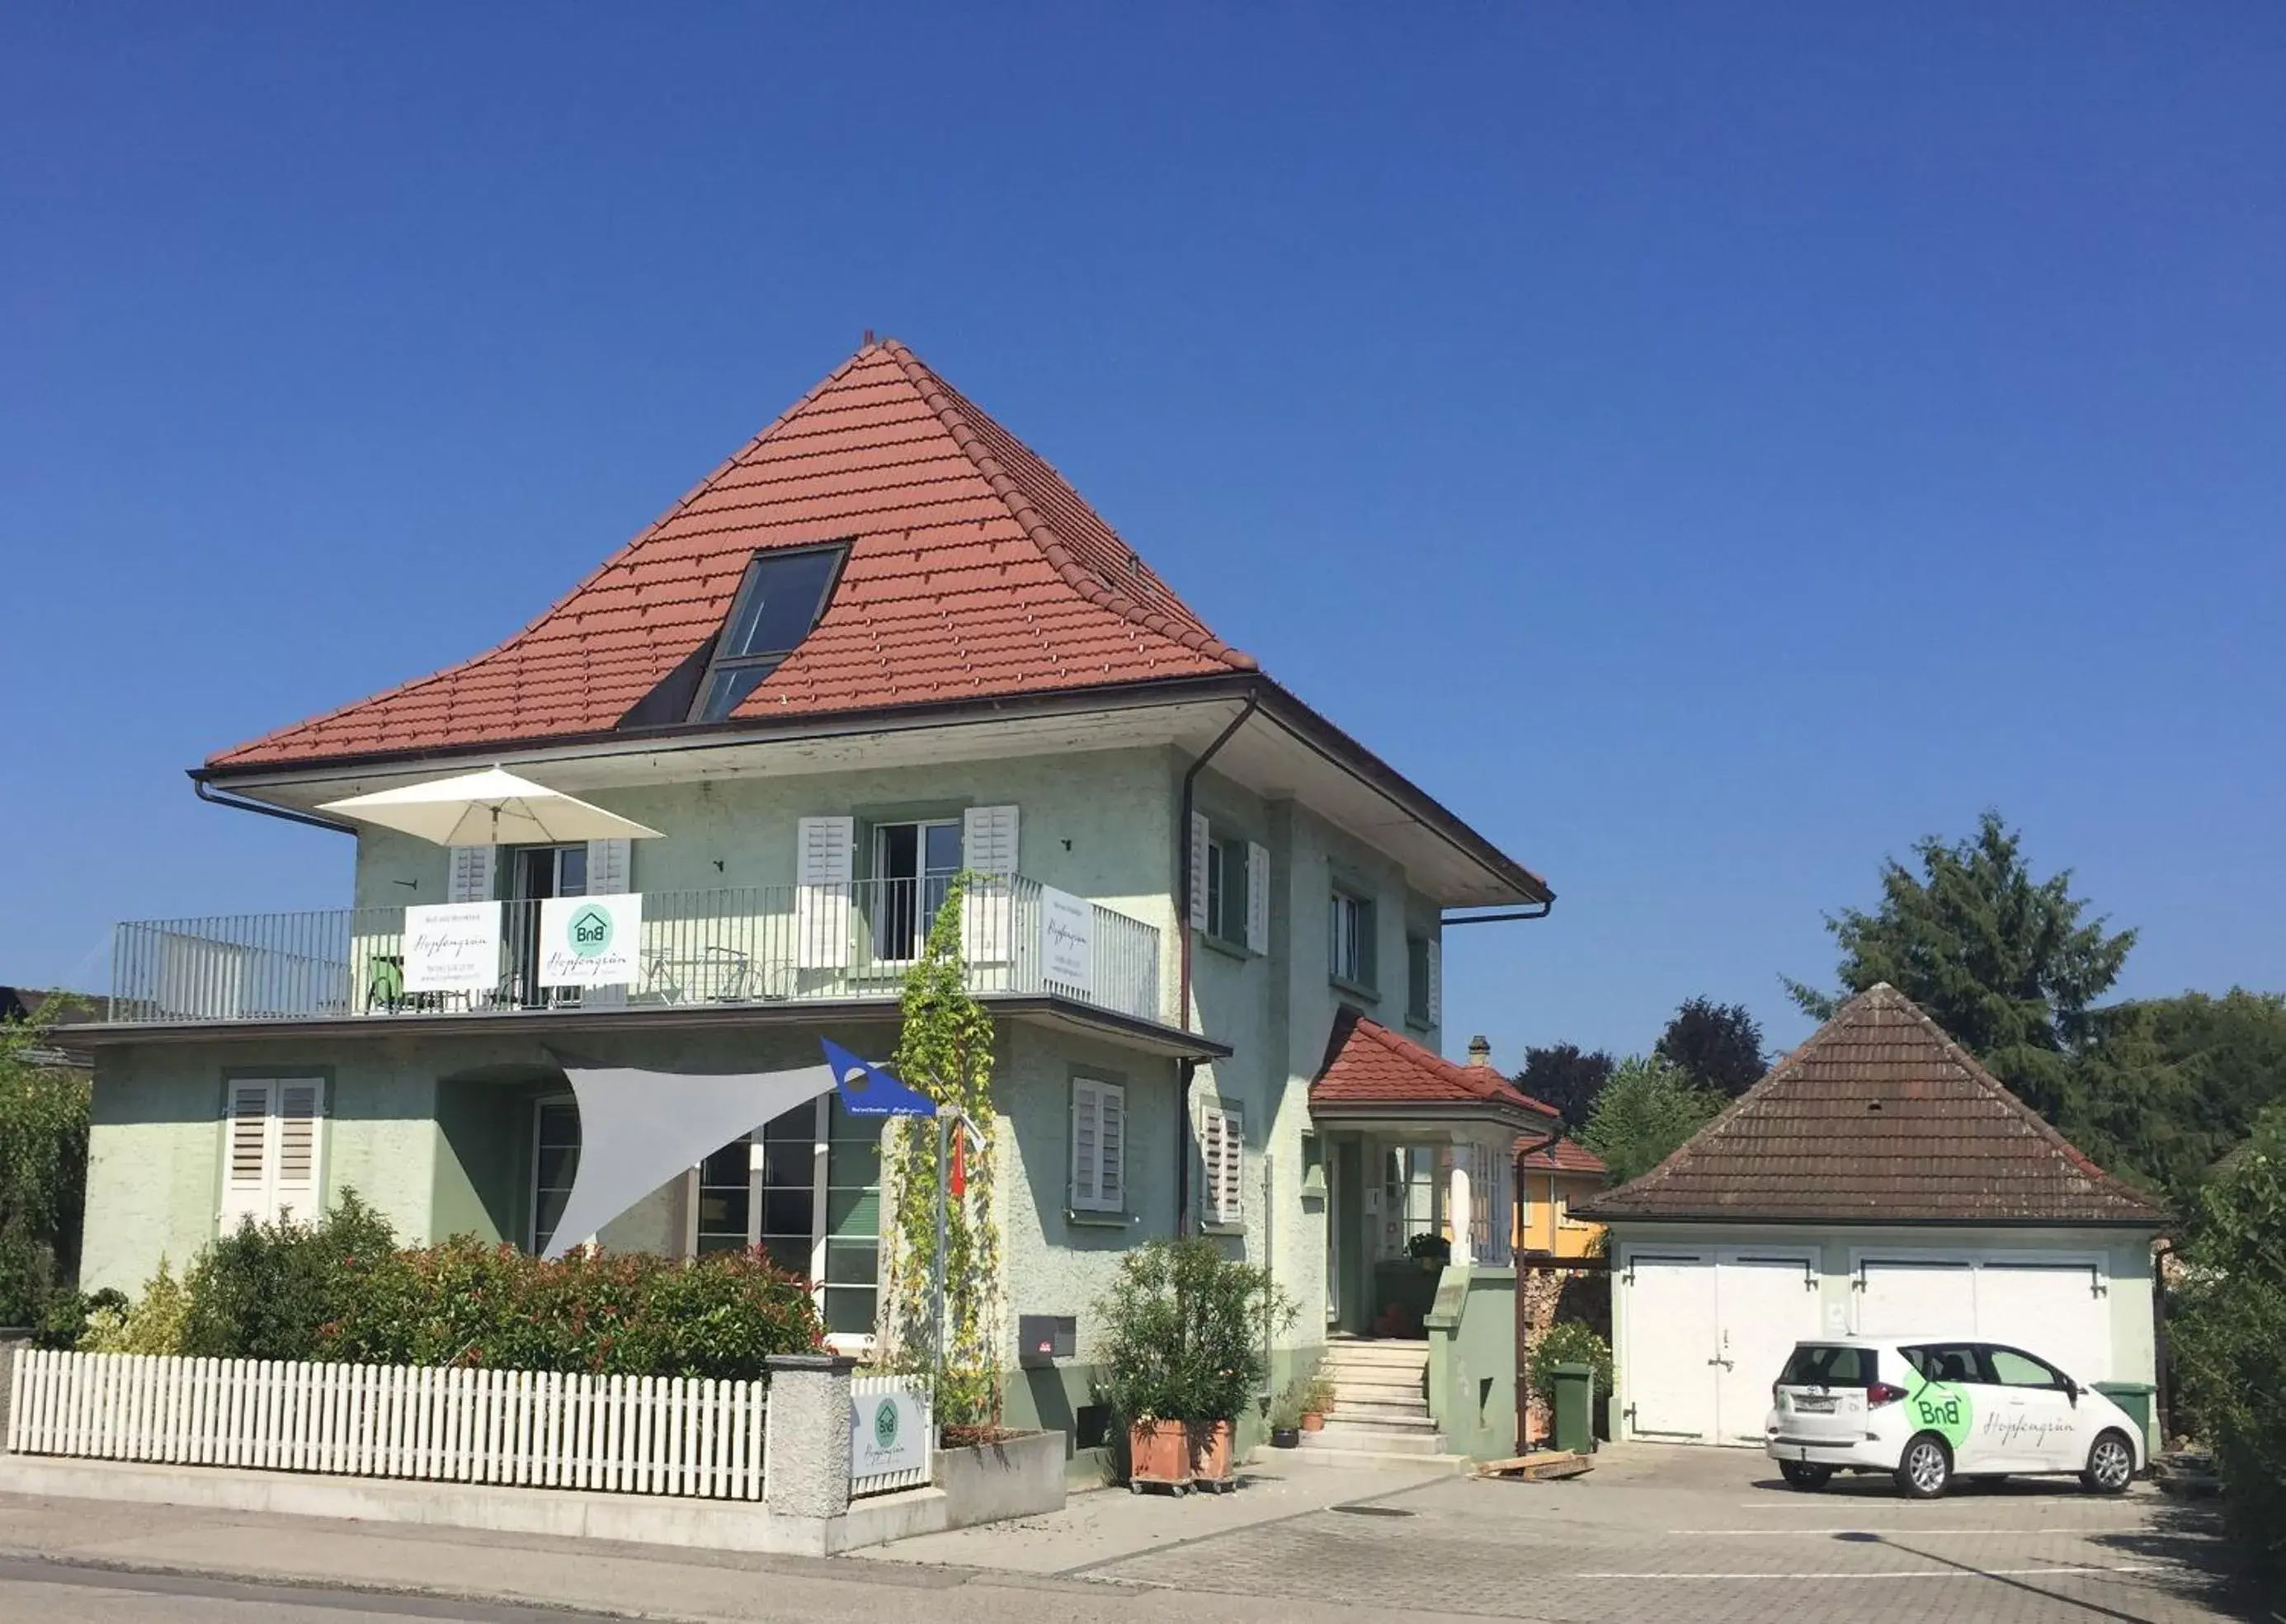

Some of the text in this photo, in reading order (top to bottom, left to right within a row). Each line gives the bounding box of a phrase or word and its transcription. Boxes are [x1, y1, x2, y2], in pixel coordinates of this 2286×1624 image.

[577, 926, 604, 942] BnB
[1919, 1401, 1959, 1424] BnB
[1983, 1411, 2075, 1447] Hopfengrün
